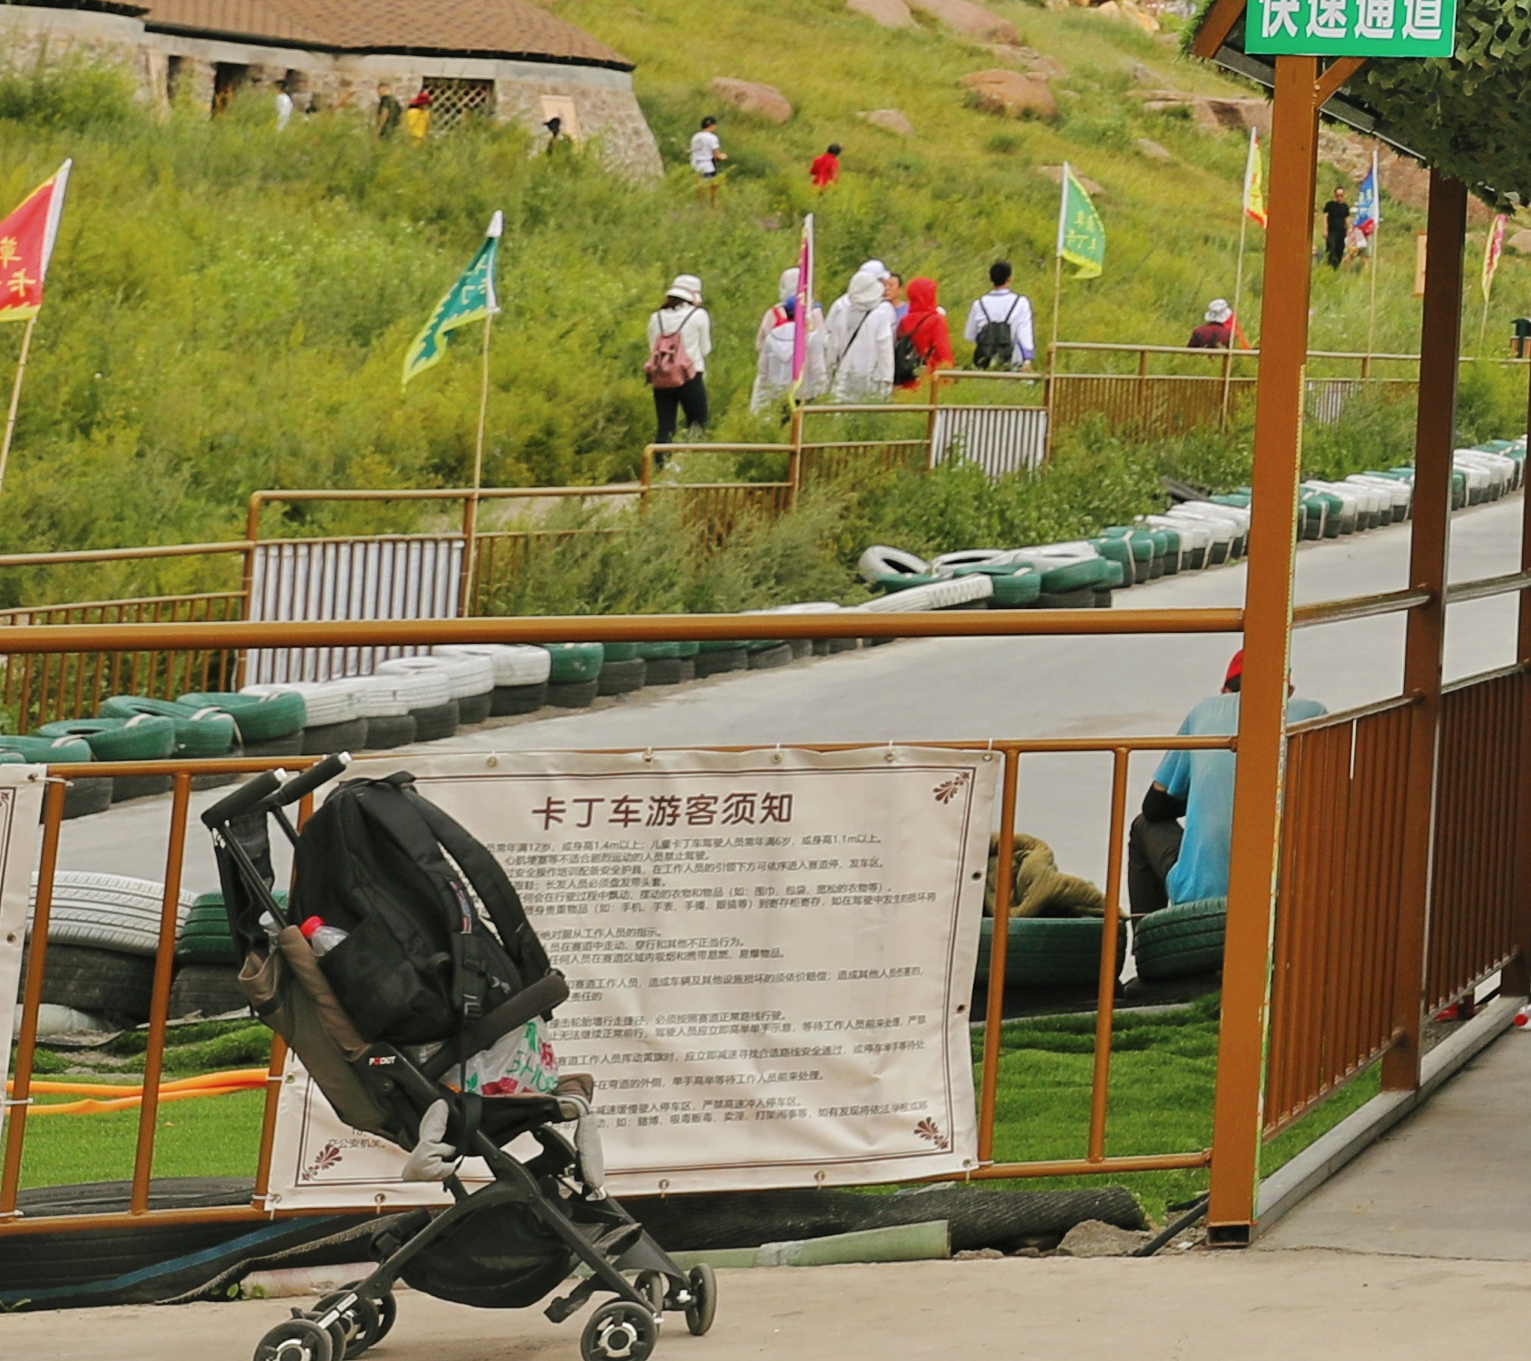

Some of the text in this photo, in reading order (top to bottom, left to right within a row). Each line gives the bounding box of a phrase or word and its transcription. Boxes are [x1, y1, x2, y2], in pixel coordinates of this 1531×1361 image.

[532, 792, 793, 831] 卡丁车游客须知
